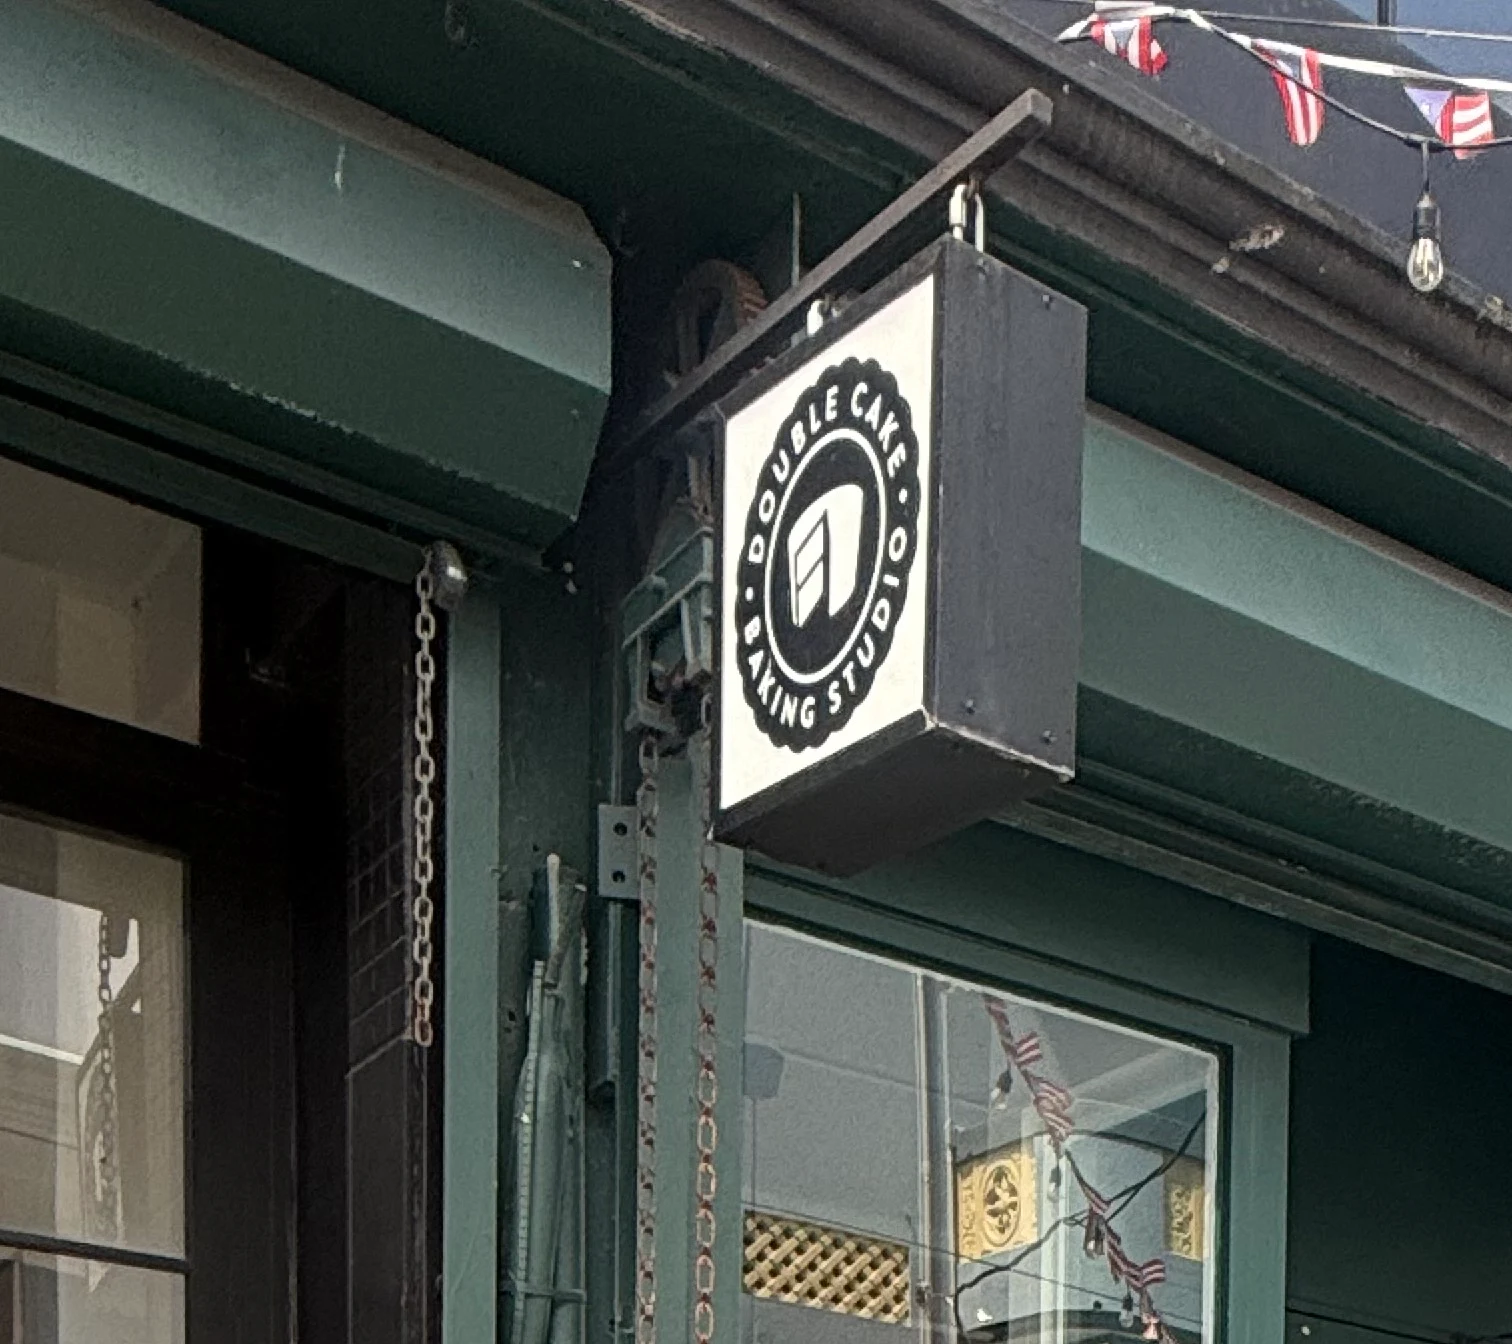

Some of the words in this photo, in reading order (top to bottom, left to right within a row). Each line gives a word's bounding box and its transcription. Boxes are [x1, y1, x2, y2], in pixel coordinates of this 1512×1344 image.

[747, 386, 840, 565] DOUBLE
[850, 381, 908, 478] CAKE
[744, 621, 817, 730] BAKING
[828, 526, 908, 715] STUDIO
